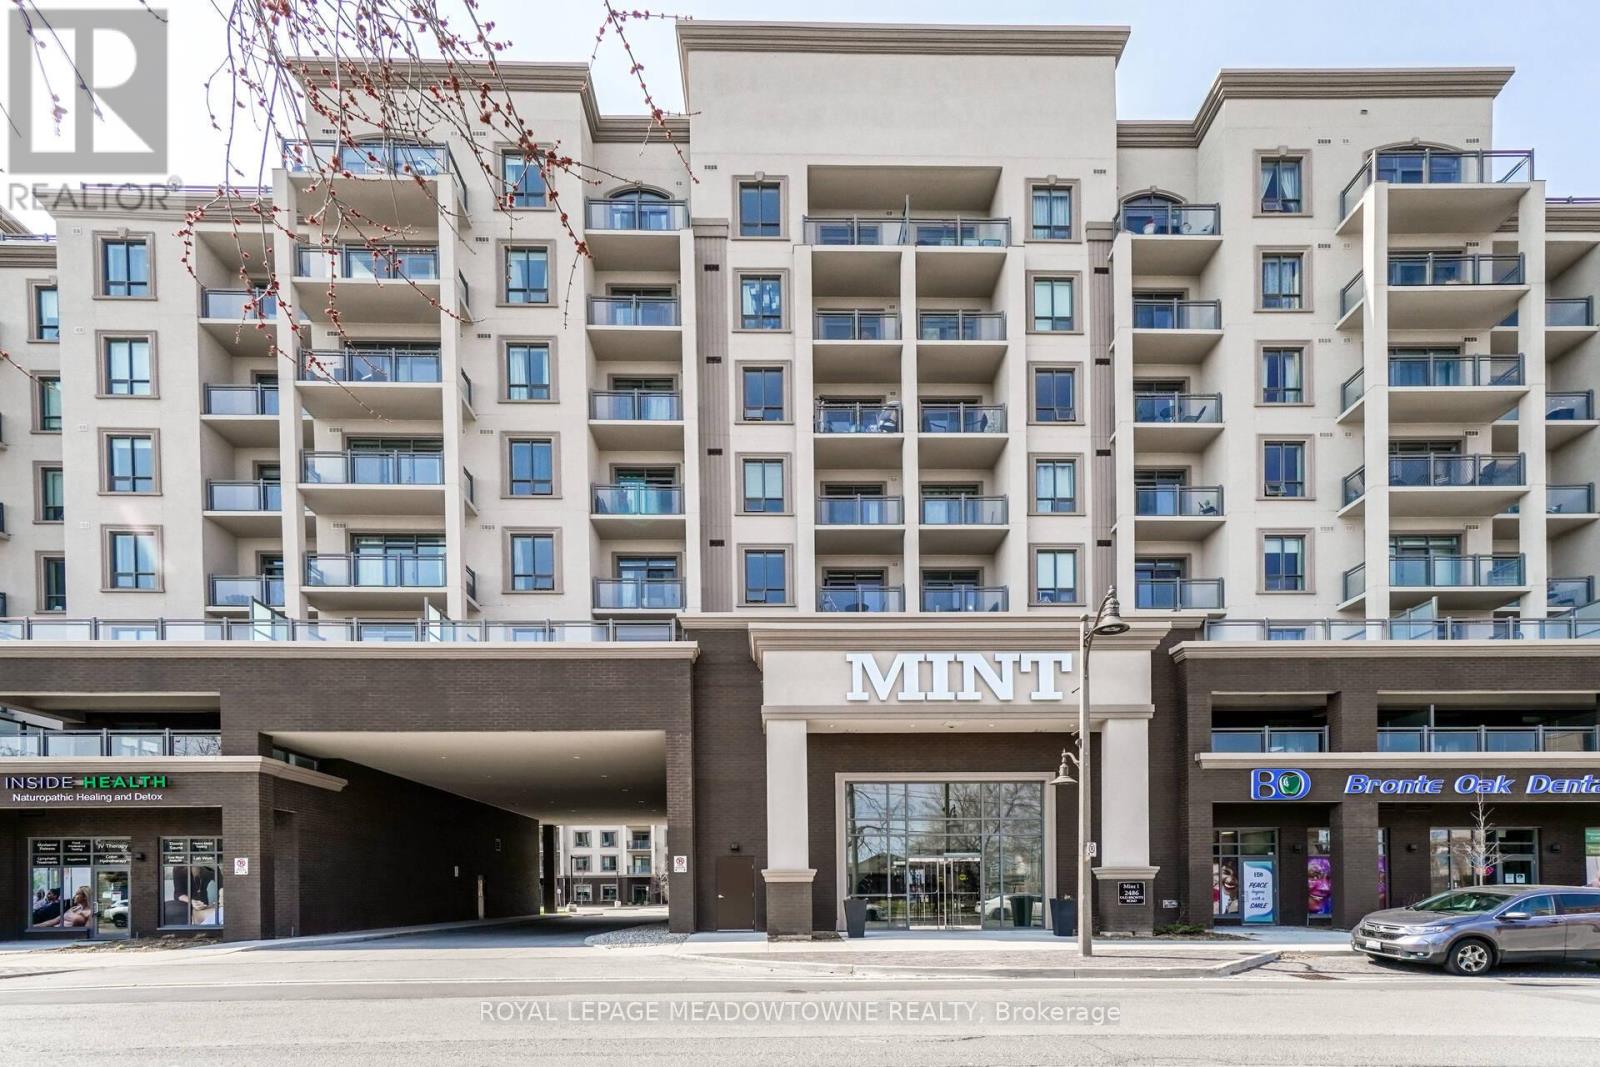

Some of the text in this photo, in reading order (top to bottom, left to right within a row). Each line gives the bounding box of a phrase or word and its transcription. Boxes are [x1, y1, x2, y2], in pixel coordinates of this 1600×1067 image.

[846, 653, 1073, 701] MINT
[5, 775, 167, 789] INSIDE HEALTH
[1344, 774, 1445, 794] Bronte
[1454, 774, 1516, 794] Oak
[12, 792, 163, 803] Naturopathic Healing and Detox
